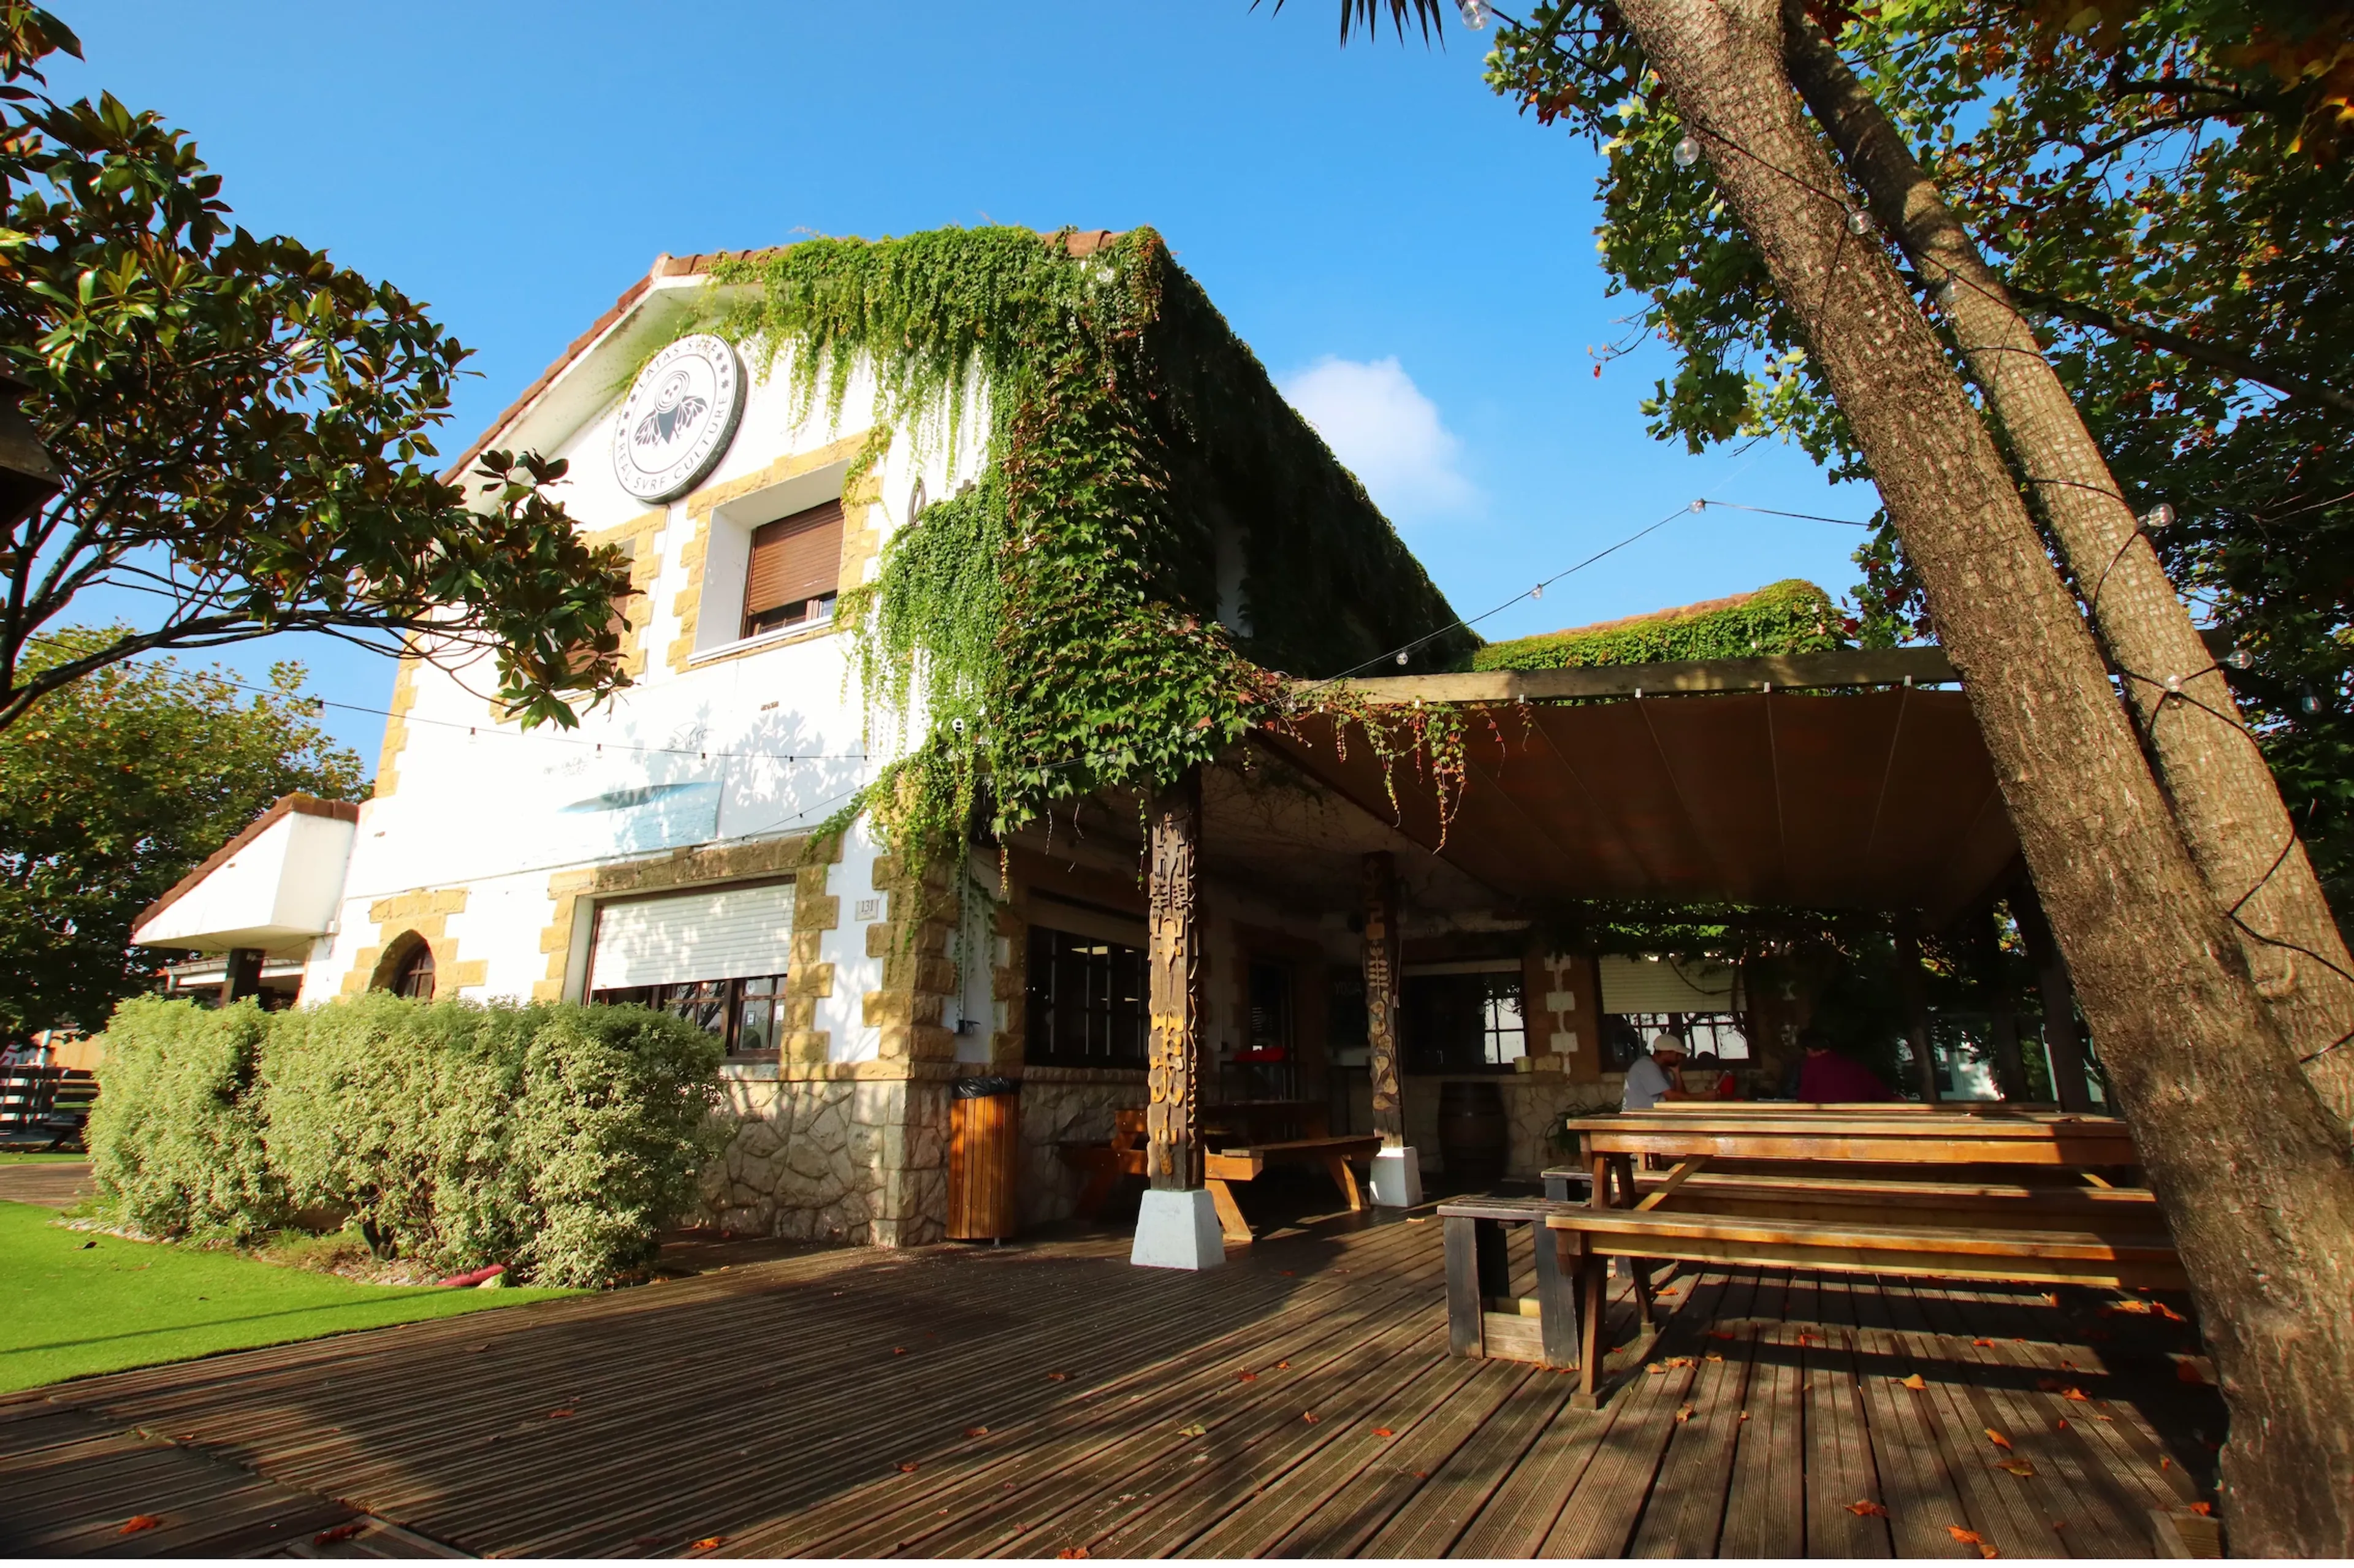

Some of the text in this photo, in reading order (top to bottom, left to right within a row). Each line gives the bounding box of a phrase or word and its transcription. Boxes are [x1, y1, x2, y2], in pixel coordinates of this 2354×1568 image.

[638, 345, 679, 389] LATAS
[618, 442, 632, 482] REAL
[674, 396, 728, 479] CULTURE
[861, 899, 874, 912] 131
